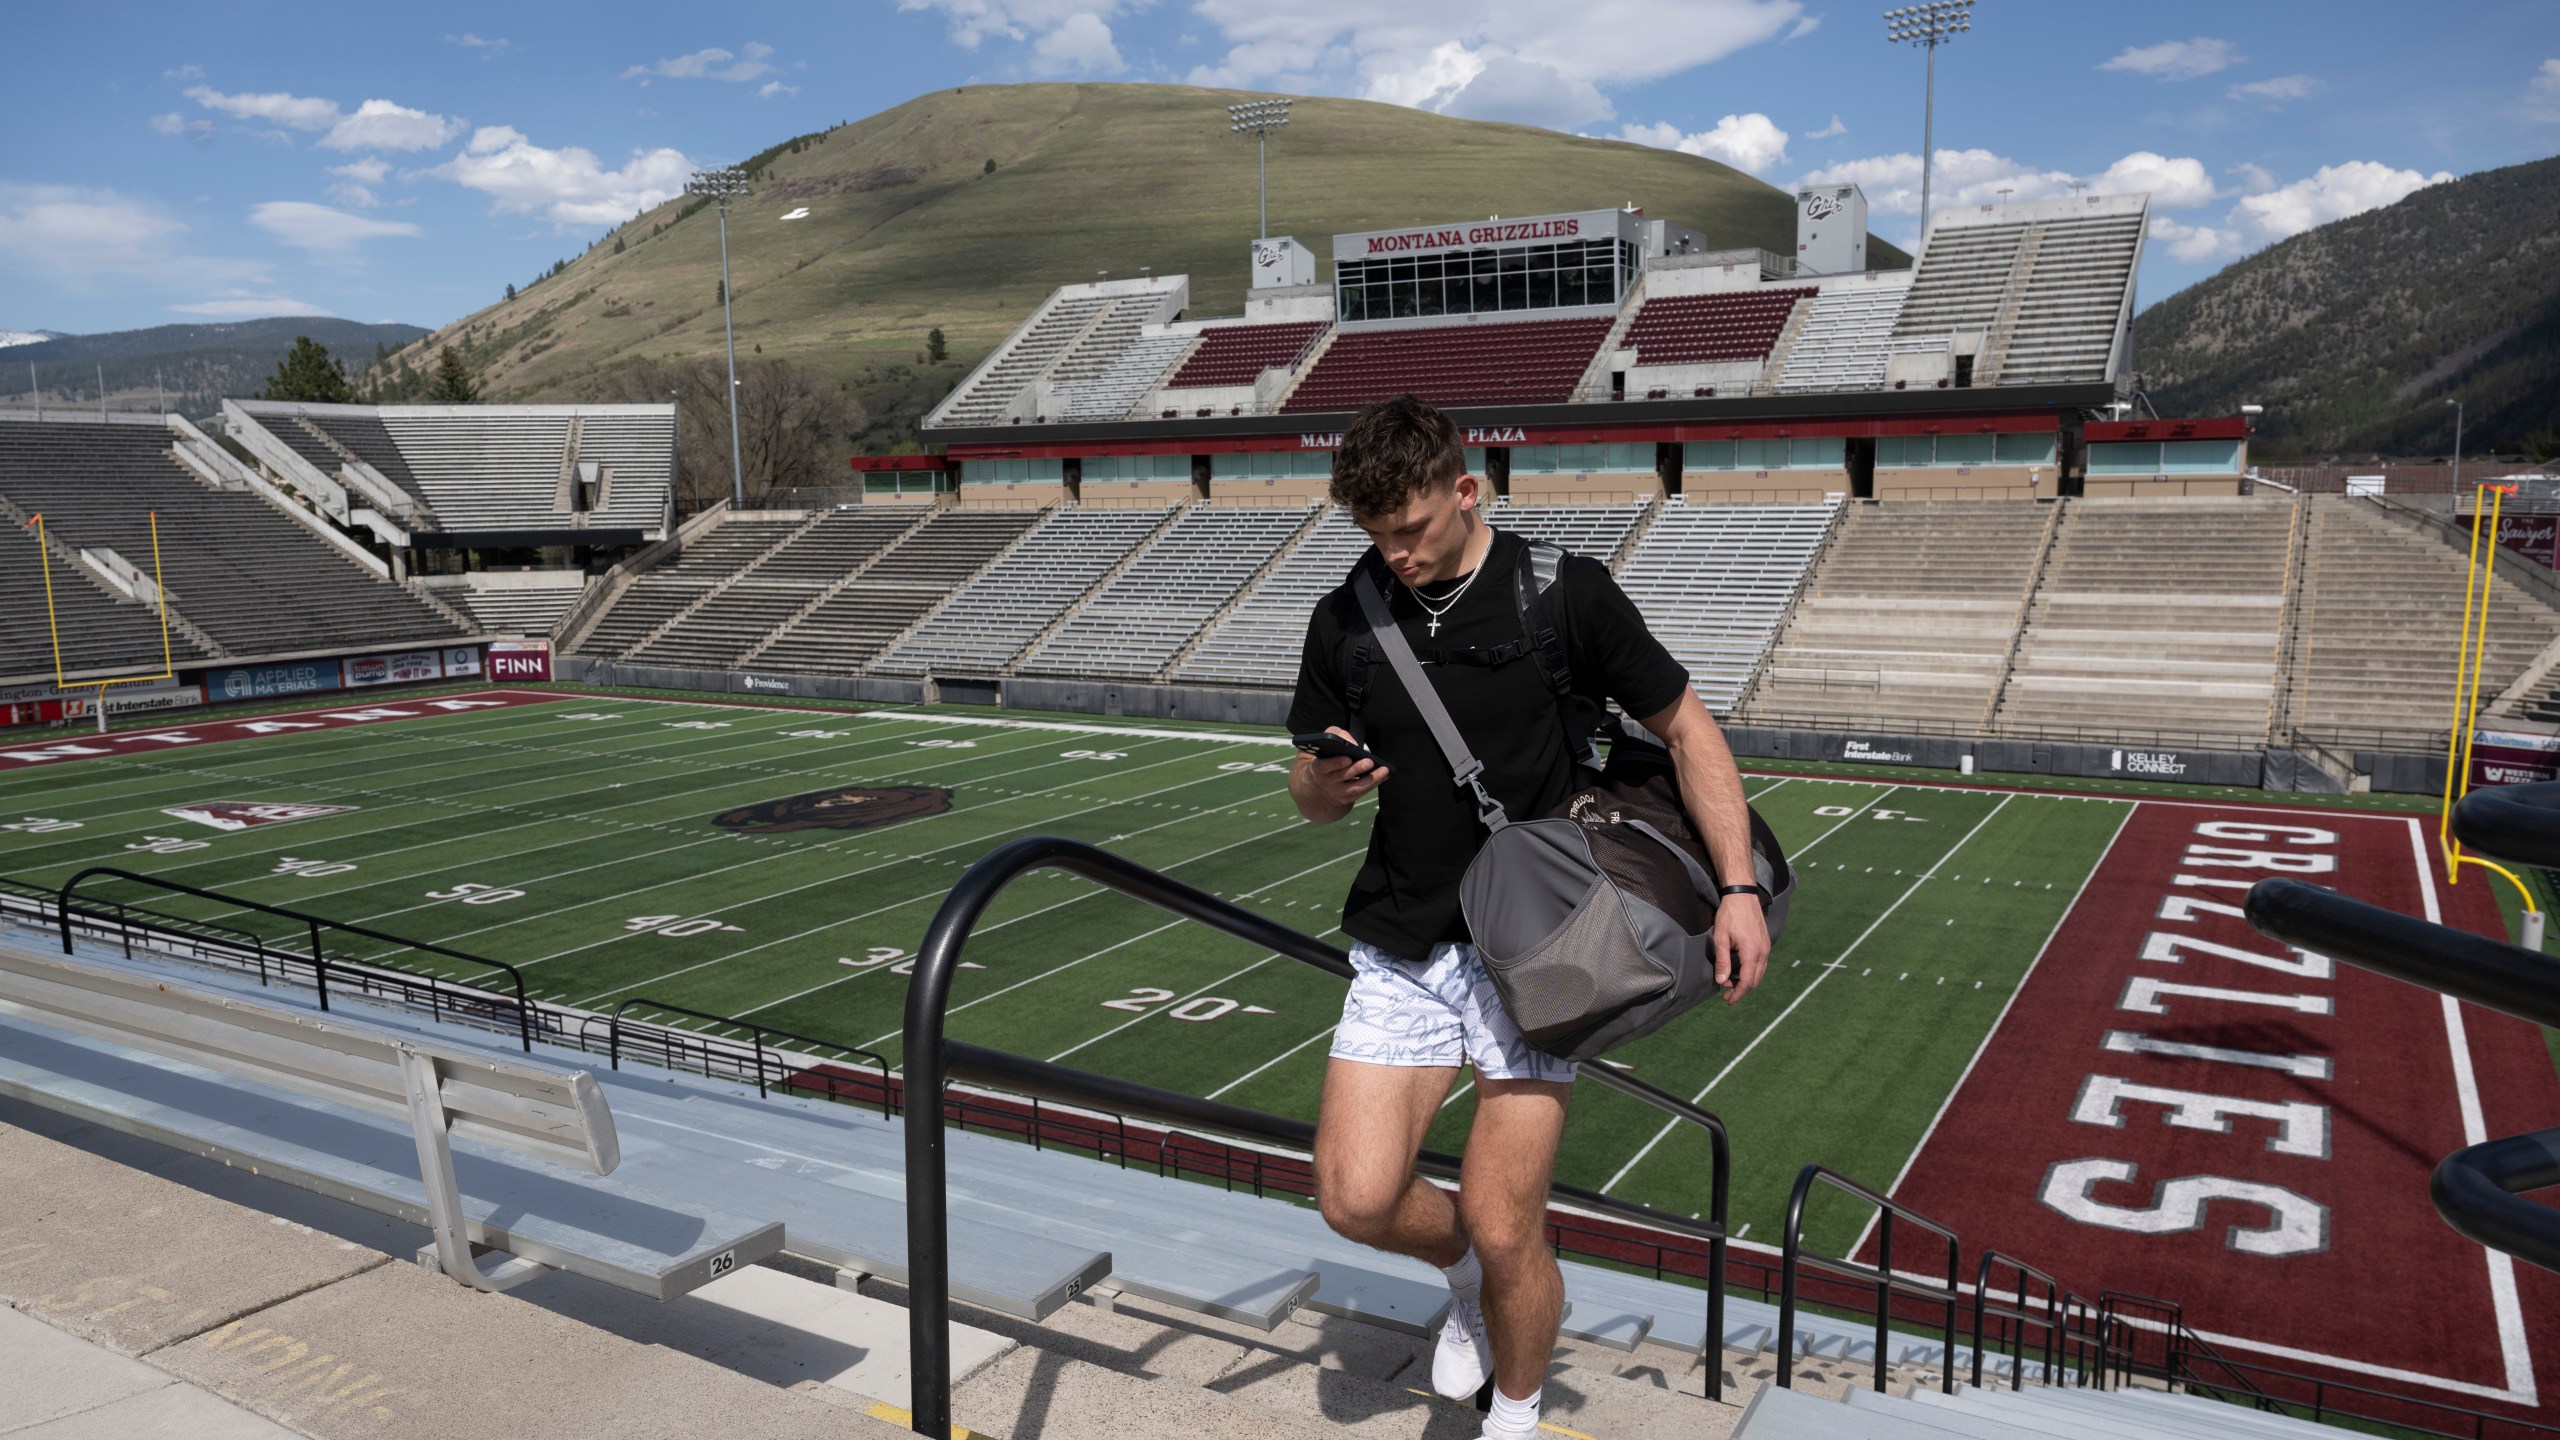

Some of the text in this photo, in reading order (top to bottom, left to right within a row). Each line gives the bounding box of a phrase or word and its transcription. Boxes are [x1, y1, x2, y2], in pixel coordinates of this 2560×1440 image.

[1807, 195, 1843, 216] Griz
[1367, 219, 1579, 253] MONTANA GRIZZLIES
[1301, 427, 1527, 448] MAJE PLAZA
[2497, 518, 2555, 547] Sawyer
[354, 662, 384, 671] town
[495, 658, 543, 673] FINN
[255, 667, 316, 683] APPLIED
[355, 670, 385, 680] pump
[754, 677, 789, 689] Providence
[255, 680, 317, 694] MATERIALS
[115, 697, 174, 711] Interstate
[174, 693, 199, 706] Bank
[1846, 741, 1869, 750] First
[1844, 750, 1912, 762] Interstate Bank
[2127, 752, 2176, 764] KELLEY
[2127, 762, 2186, 774] CONNECT
[2504, 769, 2550, 779] WESTERN
[1569, 794, 1595, 819] FOOTBALL
[1813, 806, 1905, 819] 10
[425, 883, 526, 904] 50
[624, 914, 723, 936] 40
[1101, 987, 1240, 1022] 20
[2036, 821, 2339, 1257] GRIZZLIES
[712, 1253, 733, 1275] 26
[1067, 1280, 1080, 1298] 25
[1289, 1297, 1298, 1312] 24
